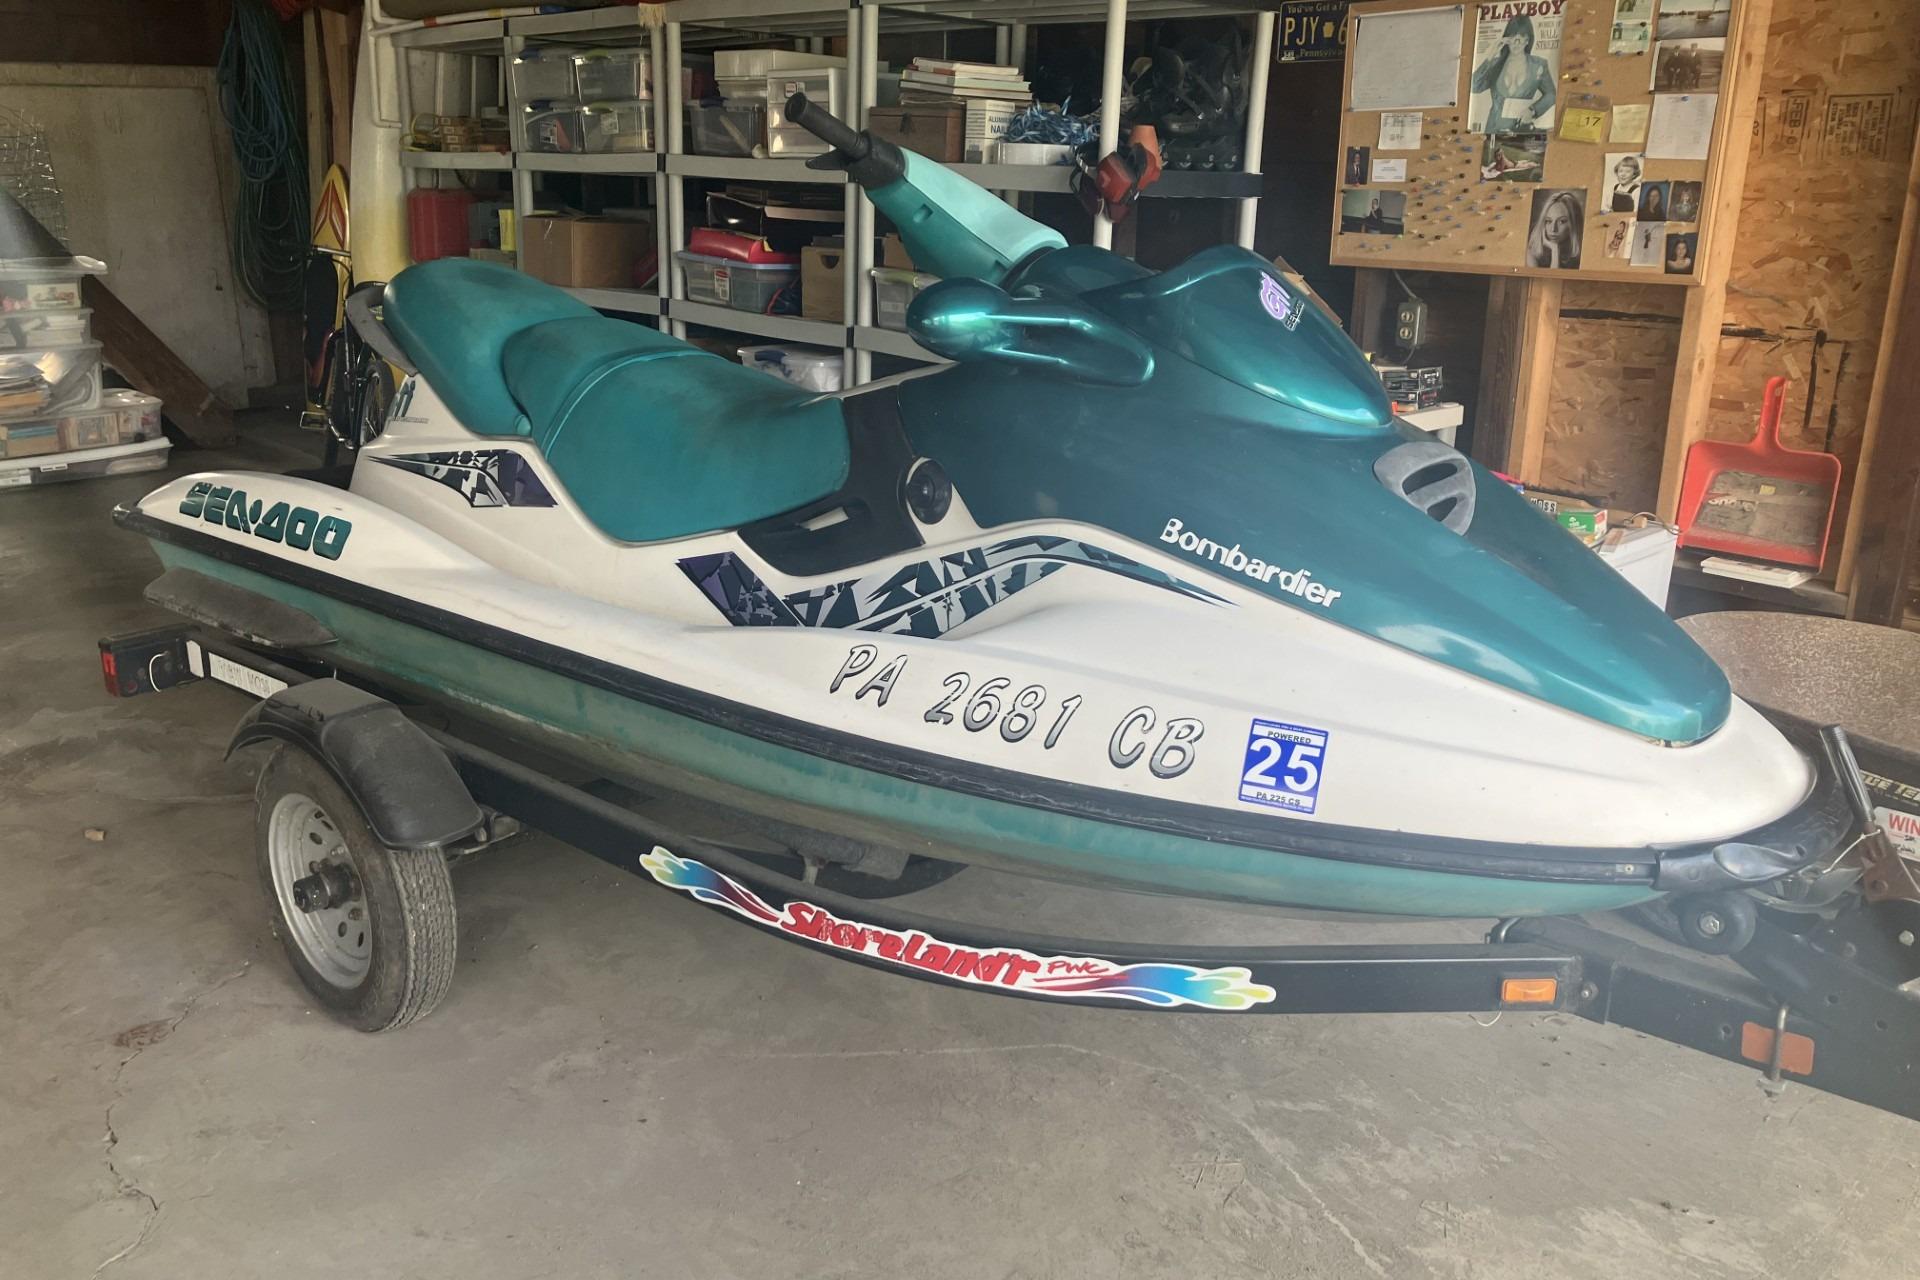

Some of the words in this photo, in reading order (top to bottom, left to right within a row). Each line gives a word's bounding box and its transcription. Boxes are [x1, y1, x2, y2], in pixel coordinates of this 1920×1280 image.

[1480, 0, 1566, 20] PLAYBOY
[1284, 15, 1320, 46] PJY
[1584, 116, 1601, 128] 17
[1160, 518, 1342, 608] Bombardier
[829, 643, 909, 708] PA
[923, 670, 1083, 751] 2681
[1107, 705, 1206, 780] CB
[1267, 730, 1312, 744] POWERED
[1243, 738, 1321, 792] 25
[1256, 791, 1267, 800] PA
[1270, 793, 1286, 803] 225
[1047, 960, 1110, 975] PWC
